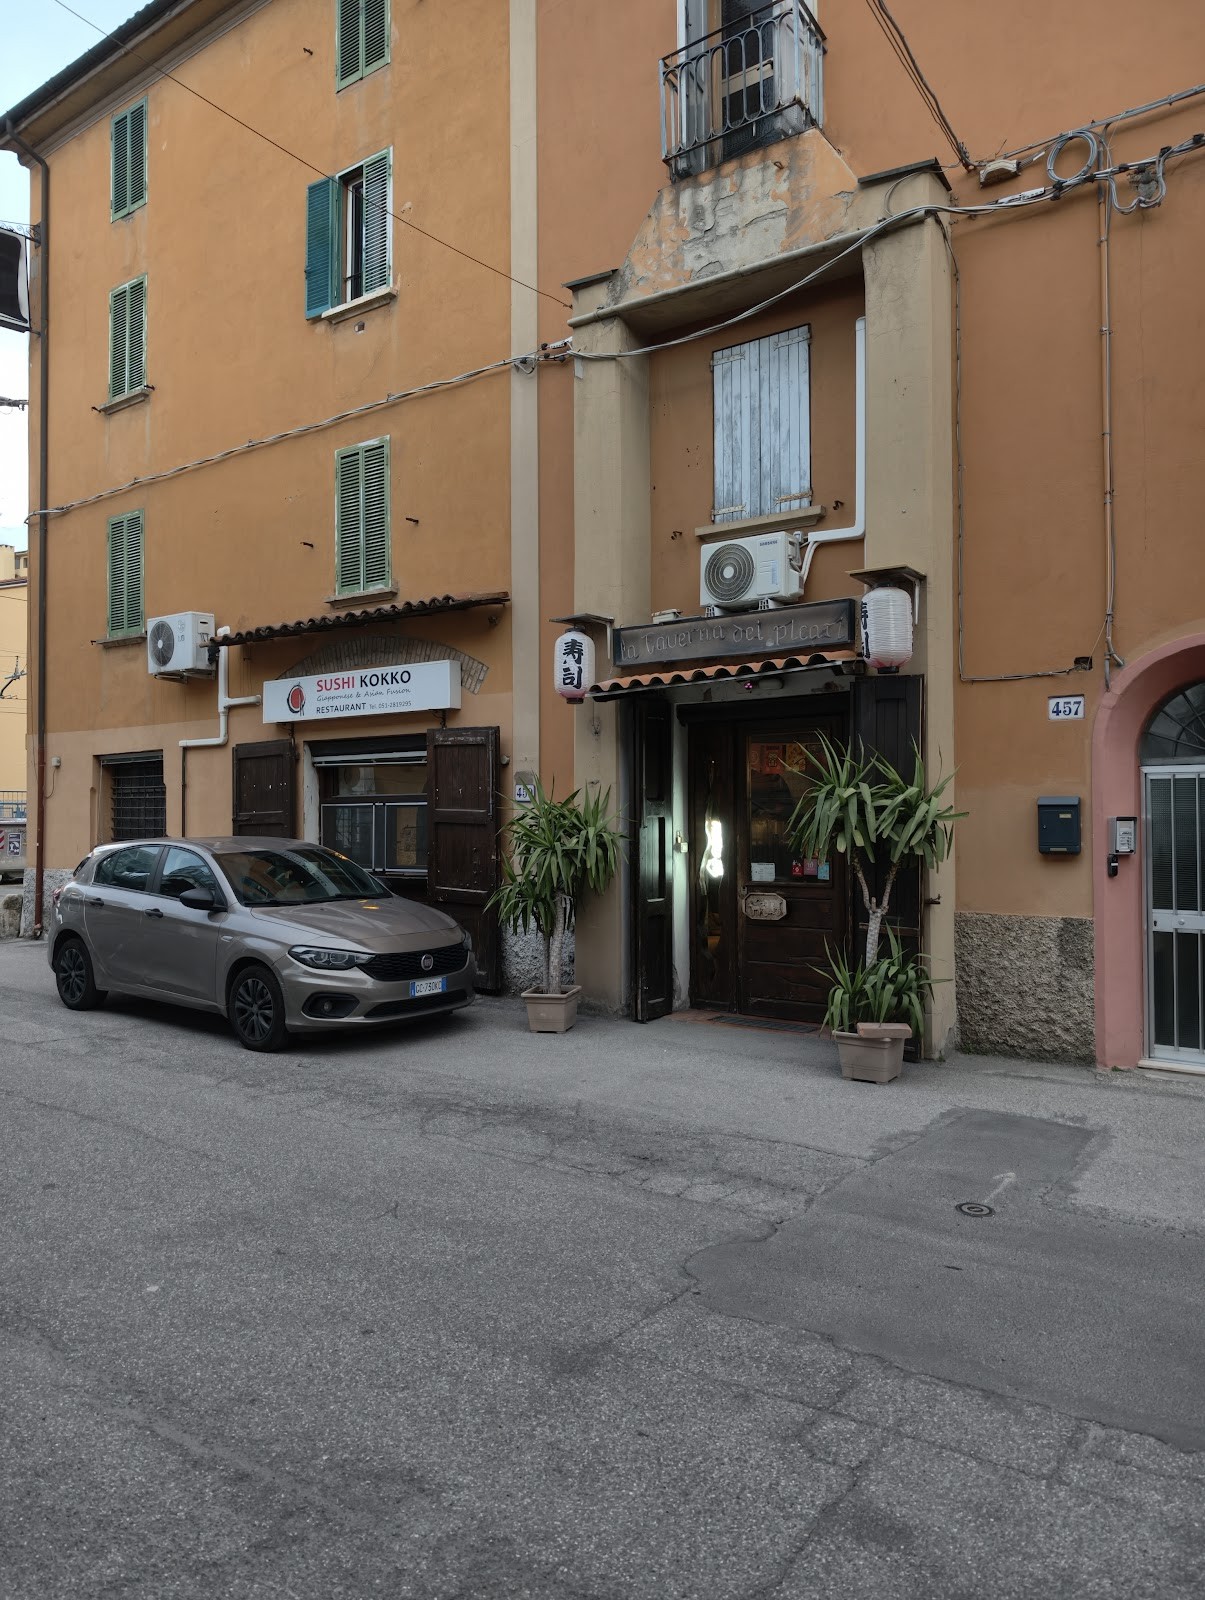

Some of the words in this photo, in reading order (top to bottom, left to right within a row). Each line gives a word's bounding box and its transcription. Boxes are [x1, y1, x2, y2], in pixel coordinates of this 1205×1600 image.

[316, 676, 355, 692] SUSHI
[360, 670, 411, 688] KOKKO
[316, 693, 353, 702] Giapponese
[316, 703, 366, 714] RESTAURANT
[1051, 701, 1082, 716] 457
